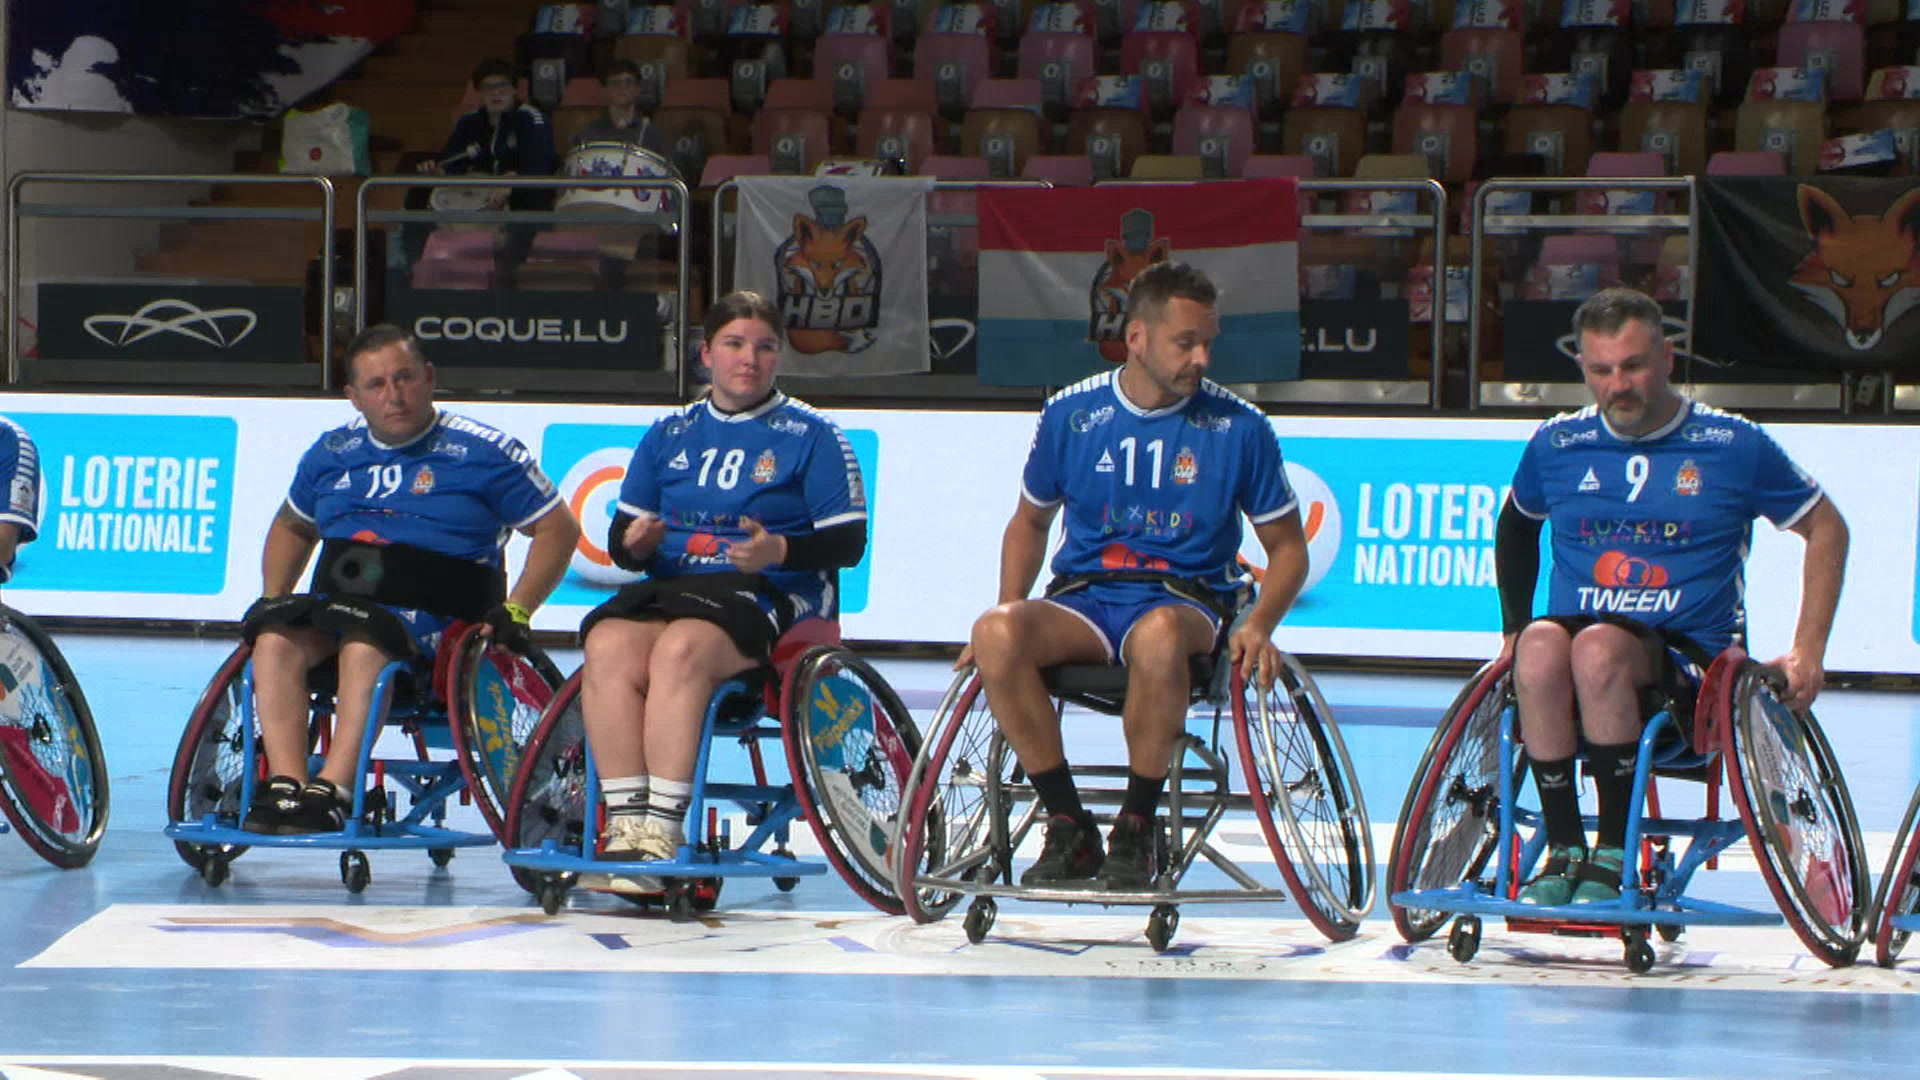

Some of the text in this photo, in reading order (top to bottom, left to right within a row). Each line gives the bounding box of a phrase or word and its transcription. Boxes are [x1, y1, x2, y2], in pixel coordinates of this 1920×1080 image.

[414, 316, 629, 344] COQUE.LU
[784, 295, 876, 329] HBD
[61, 455, 220, 510] LOTERIE
[365, 463, 403, 499] 19
[697, 447, 746, 490] 18
[1119, 436, 1165, 489] 11
[1625, 454, 1650, 503] 9
[56, 511, 215, 554] NATIONALE
[1577, 586, 1683, 613] TWEEN
